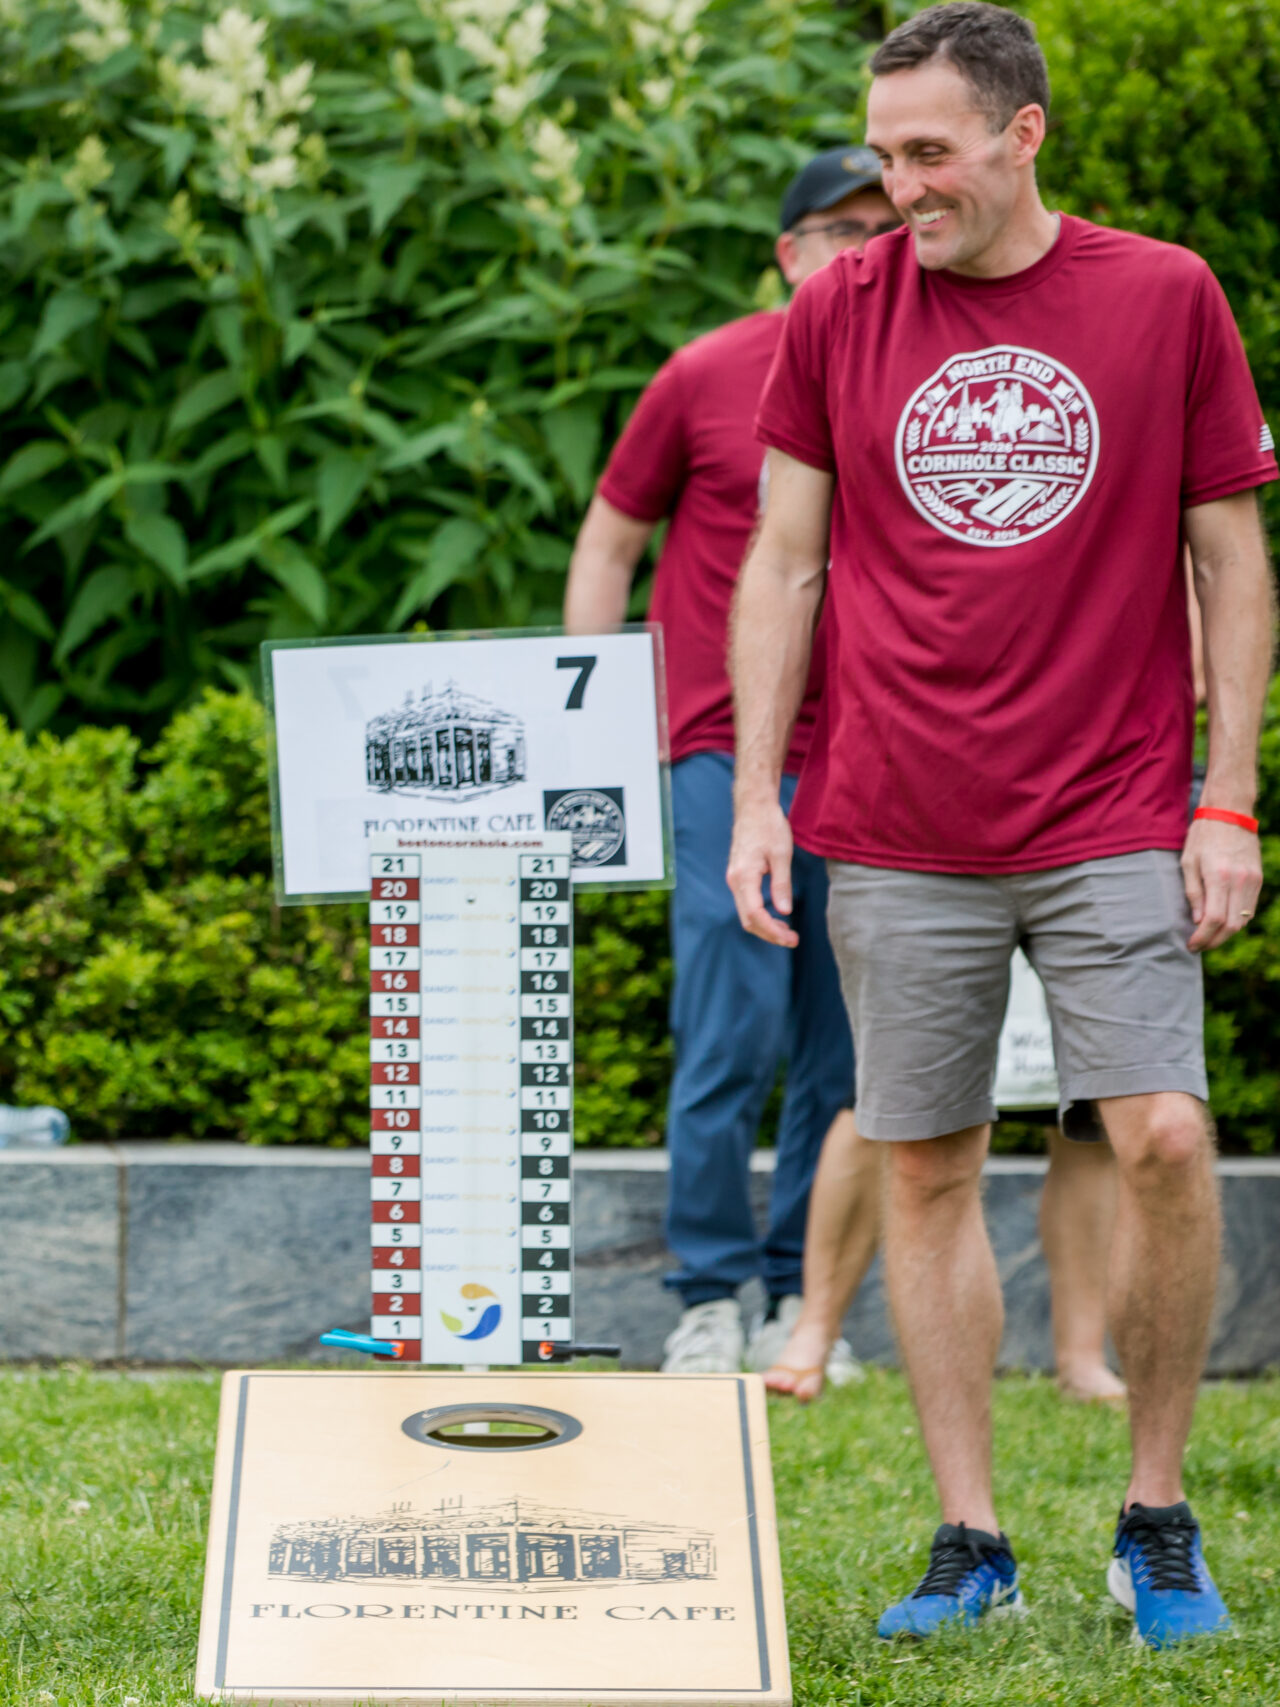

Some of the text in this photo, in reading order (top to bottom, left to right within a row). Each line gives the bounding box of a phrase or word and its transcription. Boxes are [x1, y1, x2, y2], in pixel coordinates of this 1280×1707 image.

[946, 355, 1056, 383] NORTH END
[978, 442, 1014, 453] 2026
[906, 453, 1086, 475] CORNHOLE CLASSIC
[555, 656, 597, 710] 7
[397, 838, 544, 849] bostoncornhole.com
[382, 857, 404, 873] 21
[532, 858, 554, 873] 21
[379, 880, 407, 898] 20
[530, 881, 558, 899] 20
[384, 905, 407, 920] 19
[534, 905, 557, 920] 19
[381, 926, 407, 944] 18
[531, 927, 558, 945] 18
[384, 951, 407, 966] 17
[534, 951, 557, 967] 17
[381, 972, 408, 990] 16
[531, 973, 558, 991] 16
[385, 997, 408, 1012] 15
[535, 998, 558, 1013] 15
[382, 1019, 409, 1036] 14
[532, 1020, 559, 1037] 14
[385, 1043, 408, 1058] 13
[535, 1044, 558, 1060] 13
[383, 1064, 410, 1082] 12
[533, 1065, 560, 1083] 12
[385, 1089, 406, 1104] 11
[535, 1090, 556, 1105] 11
[383, 1110, 410, 1128] 10
[533, 1111, 560, 1129] 10
[391, 1135, 402, 1150] 9
[540, 1136, 552, 1152] 9
[389, 1156, 404, 1174] 8
[538, 1158, 554, 1176] 8
[391, 1181, 403, 1196] 7
[541, 1183, 552, 1198] 7
[389, 1203, 404, 1221] 6
[538, 1205, 554, 1222] 6
[391, 1227, 402, 1243] 5
[541, 1229, 552, 1244] 5
[389, 1249, 405, 1266] 4
[538, 1251, 554, 1268] 4
[392, 1273, 403, 1289] 3
[541, 1275, 553, 1291] 3
[389, 1295, 404, 1312] 2
[538, 1296, 554, 1314] 2
[392, 1320, 402, 1335] 1
[542, 1321, 551, 1337] 1
[249, 1603, 736, 1621] FLORENTINE CAFE
